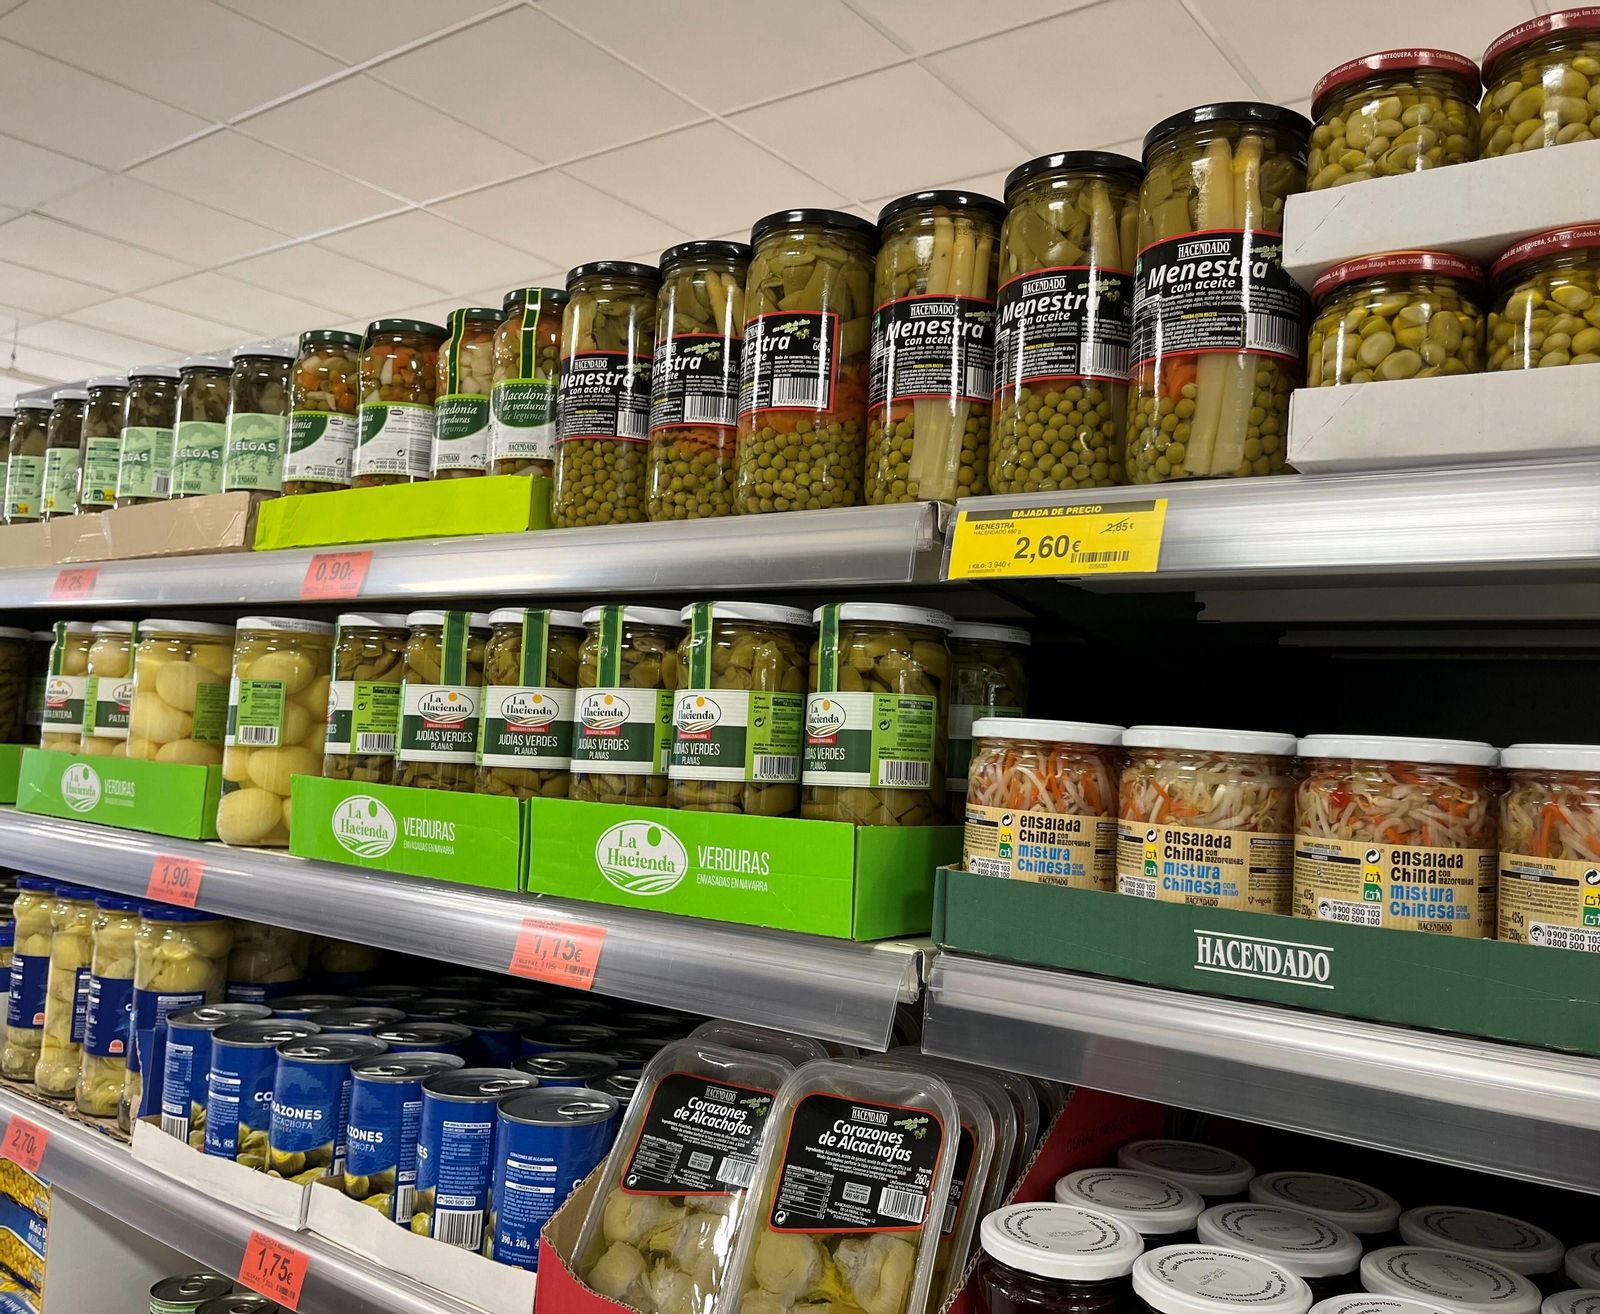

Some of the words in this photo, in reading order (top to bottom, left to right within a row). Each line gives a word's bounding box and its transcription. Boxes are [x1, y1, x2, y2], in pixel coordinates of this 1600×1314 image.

[1331, 65, 1348, 77] Fabricado
[1380, 52, 1413, 60] ANTEQUERA,
[1178, 241, 1230, 258] HACENDADO
[1516, 239, 1546, 252] ANTEQUERA,
[1547, 236, 1558, 244] S.A.
[1148, 256, 1269, 290] Menestra
[1023, 278, 1066, 296] HACENDADO
[1171, 283, 1192, 294] con
[1195, 278, 1236, 289] aceite
[911, 305, 954, 316] HACENDADO
[1002, 292, 1100, 325] Menestra
[1017, 317, 1033, 327] con
[1036, 311, 1070, 323] aceite
[886, 318, 984, 341] Menestra
[905, 337, 922, 346] con
[575, 360, 607, 369] HACENDADO
[560, 371, 635, 391] Menestra
[499, 388, 555, 402] Macedónia
[584, 385, 611, 393] aceite
[503, 403, 512, 411] de
[513, 401, 547, 410] verduras
[442, 415, 470, 424] verduras
[503, 412, 512, 420] de
[513, 411, 546, 422] legumes
[442, 425, 468, 435] legumes
[508, 443, 537, 452] HACENDADO
[1012, 510, 1049, 518] BAJADA
[1066, 505, 1102, 514] PRECIO
[975, 522, 1015, 530] MENESTRA
[430, 694, 441, 703] La
[513, 696, 525, 705] La
[589, 698, 599, 707] La
[682, 699, 691, 710] La
[423, 703, 467, 713] Hacienda
[506, 705, 552, 715] Hacienda
[584, 707, 623, 717] Hacienda
[811, 705, 818, 714] La
[51, 711, 72, 719] ENTERA
[678, 709, 715, 721] Hacienda
[415, 730, 440, 741] JUDÍAS
[442, 732, 473, 743] VERDES
[498, 734, 523, 745] JUDÍAS
[526, 735, 558, 747] VERDES
[430, 742, 454, 751] PLANAS
[514, 746, 538, 755] PLANAS
[598, 738, 629, 751] VERDES
[690, 743, 720, 756] VERDES
[589, 751, 609, 760] PLANAS
[817, 747, 846, 760] VERDES
[681, 756, 700, 765] PLANAS
[71, 771, 79, 782] La
[66, 784, 96, 797] Hacienda
[104, 779, 135, 797] VERDURAS
[348, 803, 362, 819] La
[341, 819, 389, 840] Hacienda
[403, 817, 455, 842] VERDURAS
[1020, 815, 1081, 832] ensalada
[619, 830, 637, 849] La
[1019, 830, 1056, 844] China
[1057, 839, 1091, 847] mazorquitas
[1165, 830, 1232, 849] ensalada
[403, 840, 428, 852] ENVASADAS
[435, 844, 455, 855] NAVARRA
[1018, 844, 1070, 861] mistura
[1164, 846, 1203, 862] China
[607, 848, 676, 873] Hacienda
[697, 845, 770, 876] VERDURAS
[1205, 856, 1244, 865] mazorquitas
[1391, 850, 1463, 869] ensalada
[1017, 858, 1071, 876] Chinesa
[1164, 861, 1220, 880] mistura
[1390, 867, 1437, 884] China
[1438, 870, 1451, 878] con
[1438, 878, 1474, 886] mazorquitas
[697, 874, 730, 888] ENVASADAS
[731, 878, 739, 888] EN
[740, 878, 768, 892] NAVARRA
[1163, 877, 1221, 895] Chinesa
[1390, 885, 1453, 903] mistura
[1333, 900, 1381, 910] www.mercadona.com
[1390, 901, 1454, 919] Chinesa
[1337, 906, 1350, 915] 900
[1351, 908, 1365, 916] 500
[1366, 910, 1381, 918] 103
[1337, 914, 1350, 922] 800
[1351, 915, 1364, 924] 500
[1366, 918, 1380, 926] 100
[1511, 911, 1524, 927] 425g
[1417, 921, 1453, 933] HACENDADO
[1553, 931, 1567, 940] 900
[1569, 934, 1585, 942] 500
[1553, 939, 1567, 948] 800
[1569, 942, 1584, 950] 500
[1197, 936, 1330, 982] HACENDADO
[705, 1087, 737, 1102] HACENDADO
[688, 1096, 748, 1121] Corazones
[674, 1106, 688, 1120] de
[689, 1112, 752, 1136] Alcachofas
[851, 1109, 888, 1124] HACENDADO
[833, 1119, 905, 1145] Corazones
[818, 1131, 835, 1147] de
[837, 1136, 912, 1162] Alcachofas
[29, 1219, 42, 1236] Maíz
[1218, 1253, 1249, 1262] perfecto
